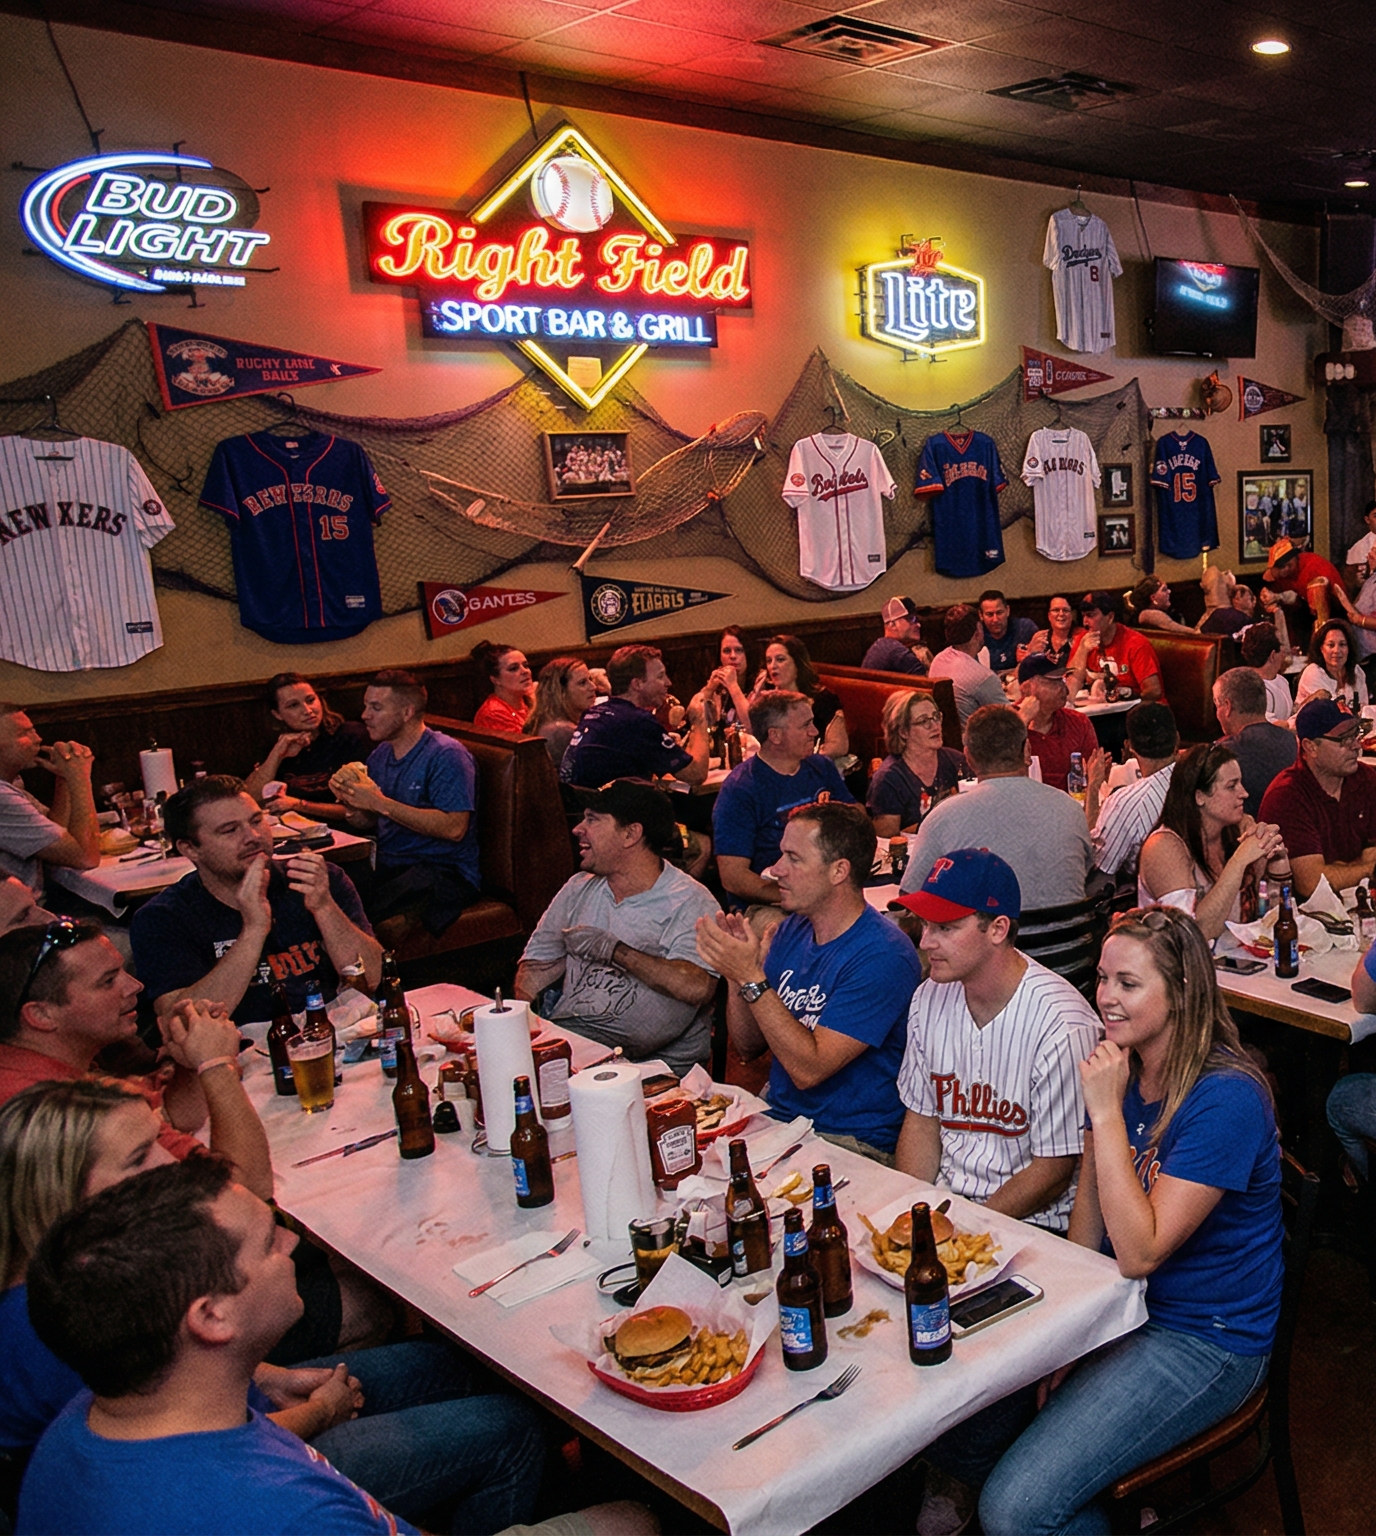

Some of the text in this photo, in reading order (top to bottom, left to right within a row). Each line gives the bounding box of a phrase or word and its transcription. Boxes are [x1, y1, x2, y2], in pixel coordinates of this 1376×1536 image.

[85, 172, 240, 224] BUD
[62, 212, 271, 266] LIGHT
[378, 212, 750, 301] Right Field
[437, 301, 713, 343] SPORT BAR & GRILL
[881, 272, 976, 341] Lite
[1173, 472, 1197, 503] 15
[319, 515, 349, 540] 15
[929, 1072, 1028, 1126] Phillies
